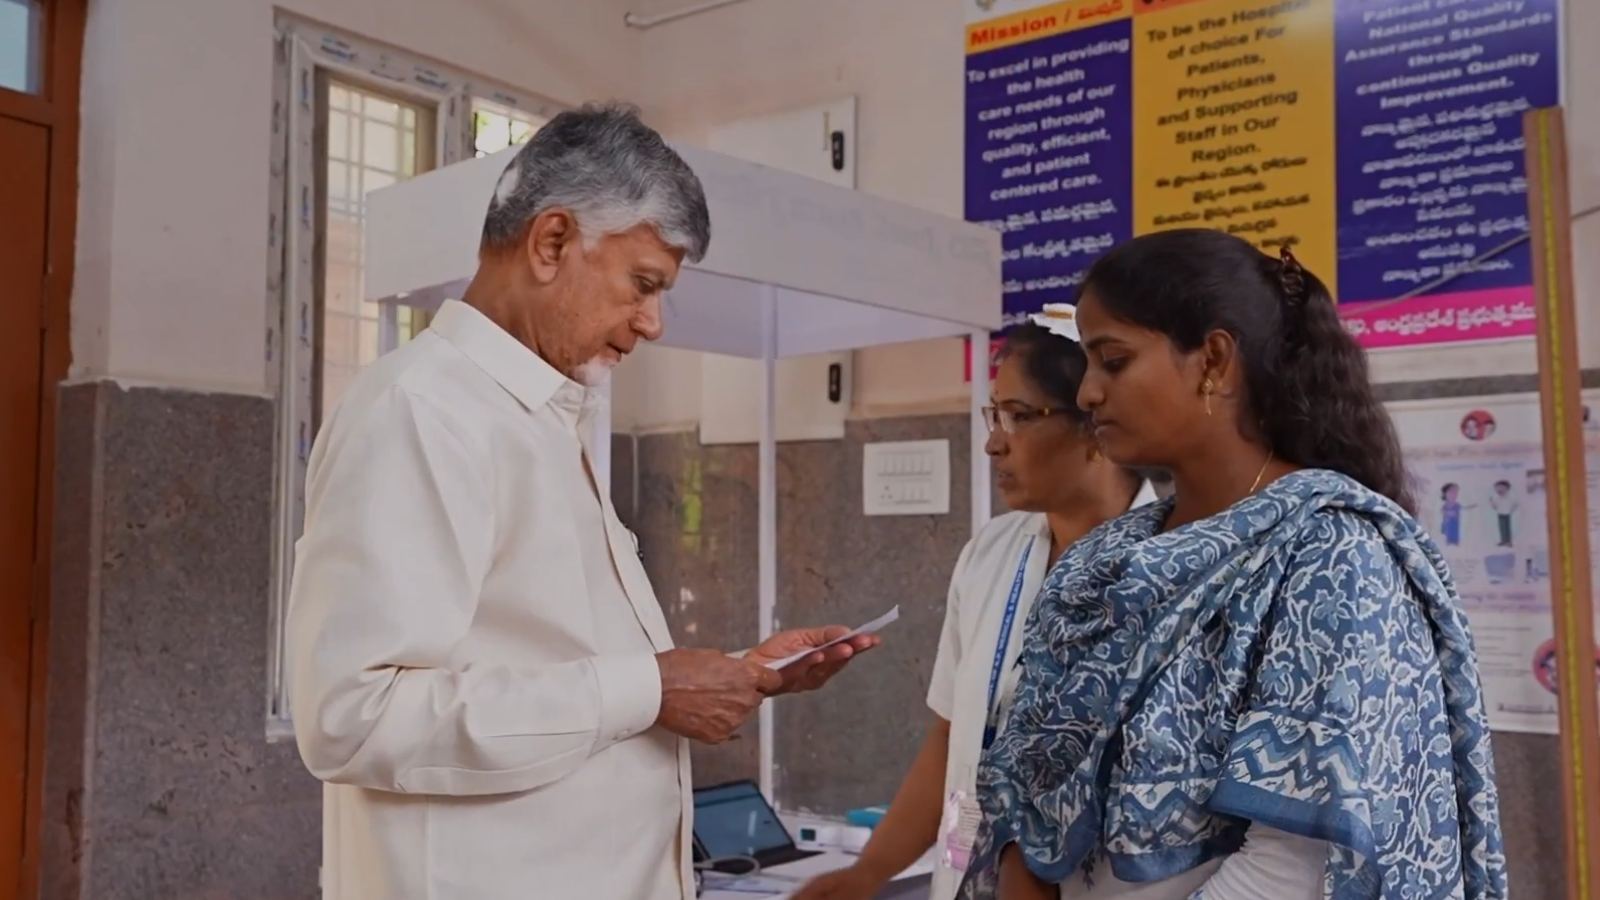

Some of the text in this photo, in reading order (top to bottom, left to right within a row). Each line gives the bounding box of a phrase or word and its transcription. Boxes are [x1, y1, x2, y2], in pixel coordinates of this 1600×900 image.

[1363, 1, 1430, 24] Patient
[1369, 1, 1525, 40] National Quality
[970, 15, 1057, 46] Mission
[1147, 28, 1167, 42] To
[1172, 25, 1193, 38] be
[1198, 17, 1227, 32] the
[1167, 26, 1285, 60] of choice For
[1344, 12, 1553, 63] Assurance Standards
[967, 38, 1130, 83] To excel in providing
[1408, 43, 1484, 67] through
[1006, 68, 1085, 95] the health
[1177, 72, 1277, 102] Physicians
[1356, 52, 1541, 95] continuous Quality
[978, 84, 1116, 121] care needs of our
[1380, 75, 1515, 109] Improvement.
[988, 107, 1105, 140] region through
[1157, 91, 1298, 127] and Supporting
[982, 128, 1111, 162] quality, efficient,
[1175, 116, 1279, 144] Staff in Our
[1002, 152, 1090, 178] and patient
[1191, 143, 1261, 163] Region.
[990, 174, 1102, 201] centered care.
